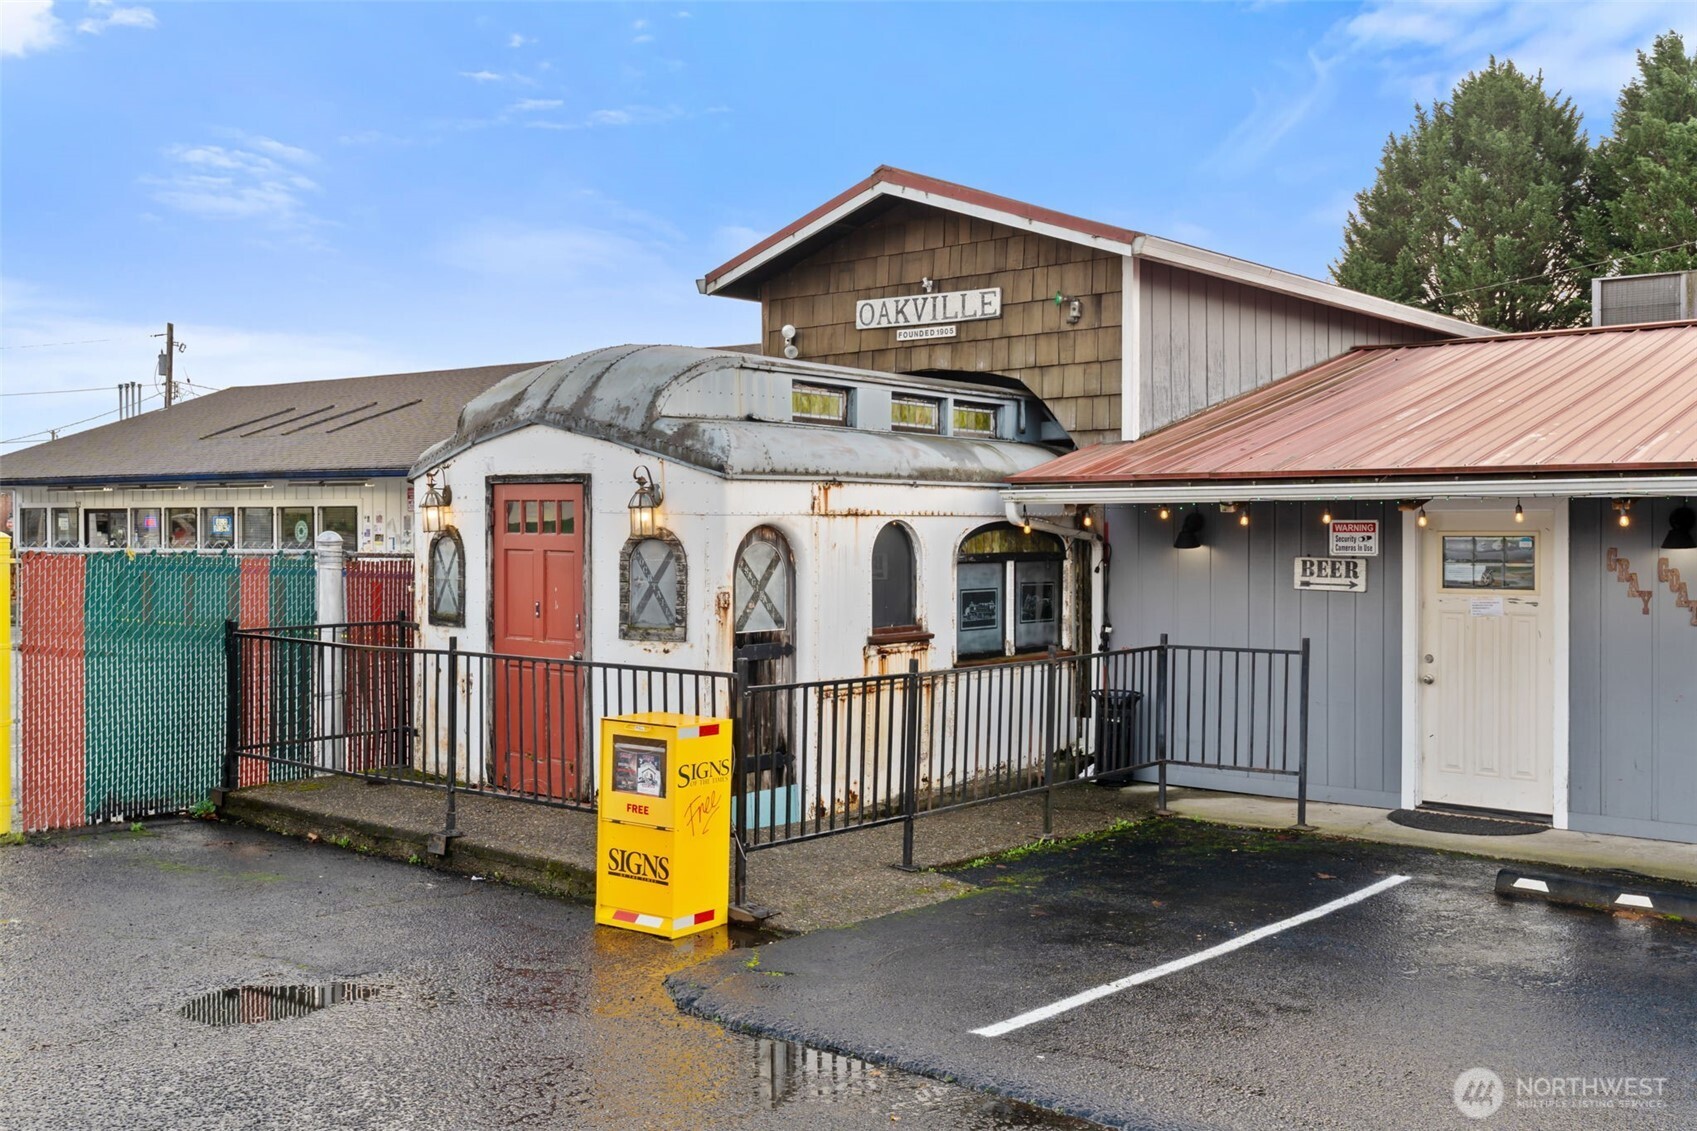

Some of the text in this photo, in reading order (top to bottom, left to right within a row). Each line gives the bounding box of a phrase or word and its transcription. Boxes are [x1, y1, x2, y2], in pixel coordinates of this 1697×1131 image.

[859, 290, 997, 327] OAKVILLE
[898, 327, 954, 339] FOUNDED 1905
[1334, 523, 1374, 532] WARNING
[1335, 535, 1357, 544] Security
[1335, 544, 1357, 552] Cameras
[1363, 544, 1373, 552] Use
[1300, 559, 1360, 580] BEER
[1606, 547, 1653, 615] GRAY
[677, 758, 730, 789] SIGNS
[626, 803, 649, 815] FREE
[684, 790, 722, 836] Free
[607, 847, 670, 881] SIGNS
